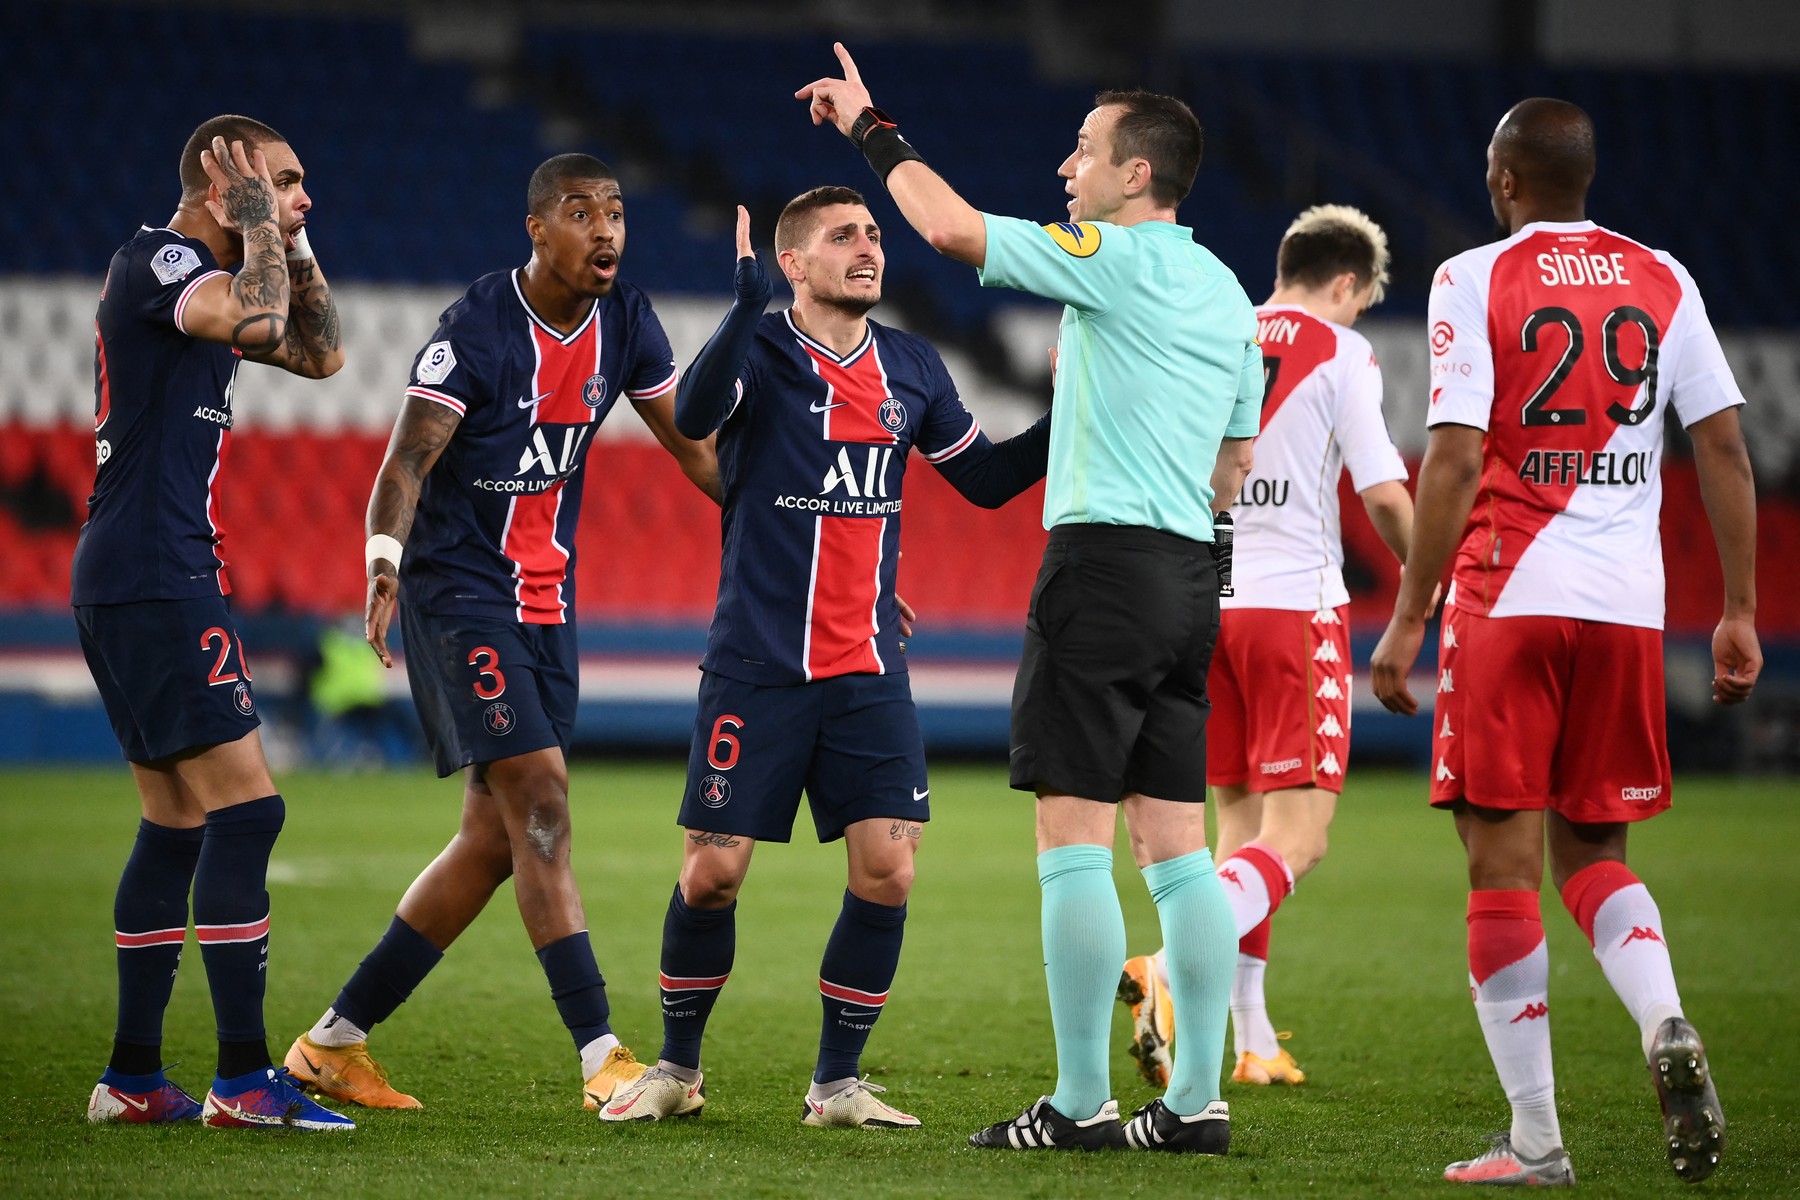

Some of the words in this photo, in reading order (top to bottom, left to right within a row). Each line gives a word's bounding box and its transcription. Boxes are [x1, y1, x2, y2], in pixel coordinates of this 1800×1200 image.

[1257, 316, 1302, 345] VIN
[1521, 305, 1659, 427] 29
[193, 405, 228, 425] ACCOR
[1519, 449, 1653, 486] AFFLELOU
[473, 478, 524, 492] ACCOR
[1232, 478, 1290, 507] LOU
[774, 494, 830, 512] ACCOR
[833, 500, 864, 514] LIVE
[467, 646, 506, 700] 3
[486, 703, 508, 715] PARIS
[707, 713, 745, 771] 6
[705, 776, 727, 787] PARIS
